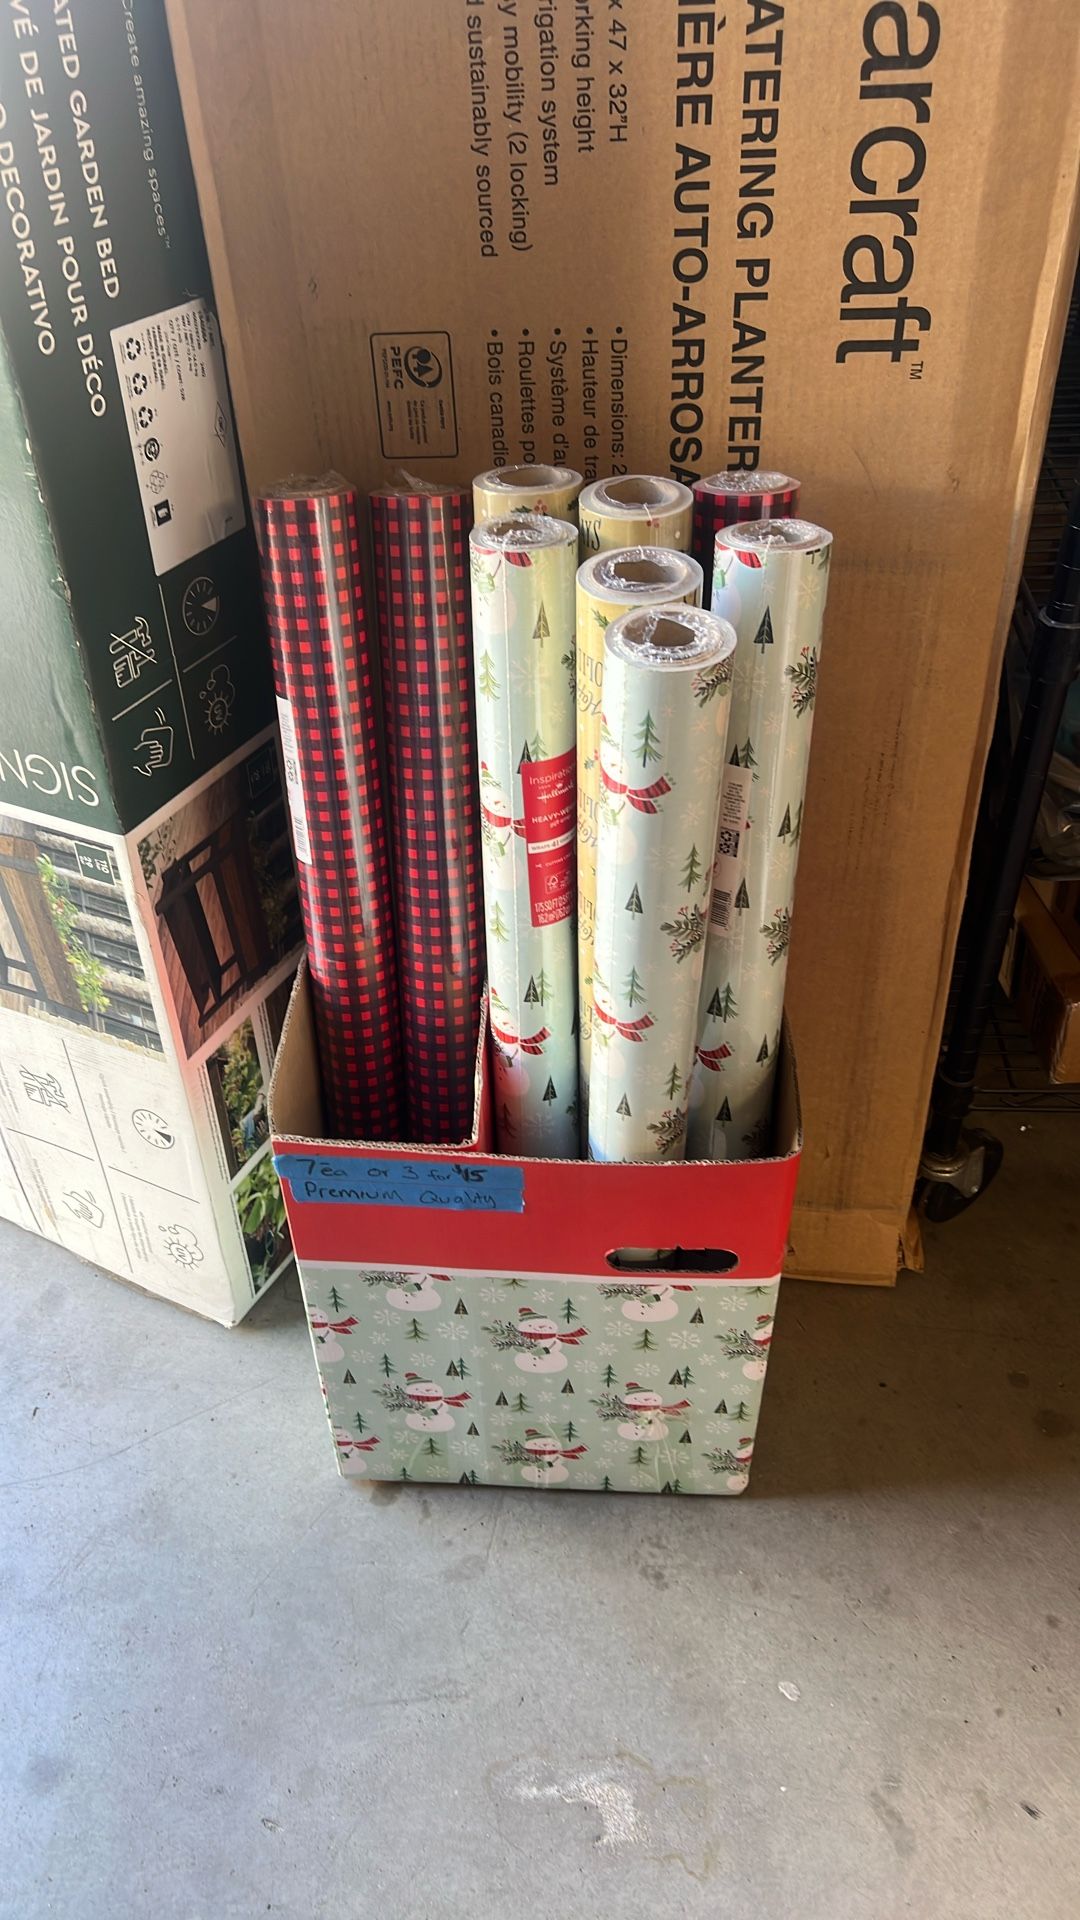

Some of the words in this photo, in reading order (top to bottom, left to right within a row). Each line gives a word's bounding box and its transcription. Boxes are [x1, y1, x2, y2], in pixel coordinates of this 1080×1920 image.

[18, 51, 44, 98] DE
[502, 26, 529, 125] mobility
[608, 19, 628, 51] 47
[608, 59, 624, 75] x
[121, 0, 140, 68] Create
[134, 75, 154, 162] amazing
[467, 15, 488, 156] sustainably
[572, 80, 595, 153] height
[735, 0, 785, 239] ATERING
[30, 109, 69, 227] JARDIN
[506, 132, 528, 155] (2
[538, 101, 559, 186] system
[69, 89, 108, 229] GARDEN
[96, 237, 120, 299] BED
[476, 165, 498, 258] sourced
[510, 160, 533, 252] locking)
[57, 236, 88, 328] POUR
[76, 333, 107, 418] DÉCO
[390, 346, 404, 390] PEFC
[486, 342, 504, 384] Bois
[521, 340, 537, 433] Roulettes
[550, 342, 568, 422] Système
[581, 339, 599, 414] Hauteur
[610, 339, 628, 458] Dimensions:
[726, 257, 770, 473] PLANTER
[583, 421, 599, 448] de
[584, 456, 599, 486] tra
[580, 518, 602, 551] YS
[304, 1181, 402, 1201] Premium
[418, 1189, 496, 1209] Quality
[366, 1167, 388, 1178] or
[402, 1166, 418, 1180] 3
[428, 1166, 452, 1182] for
